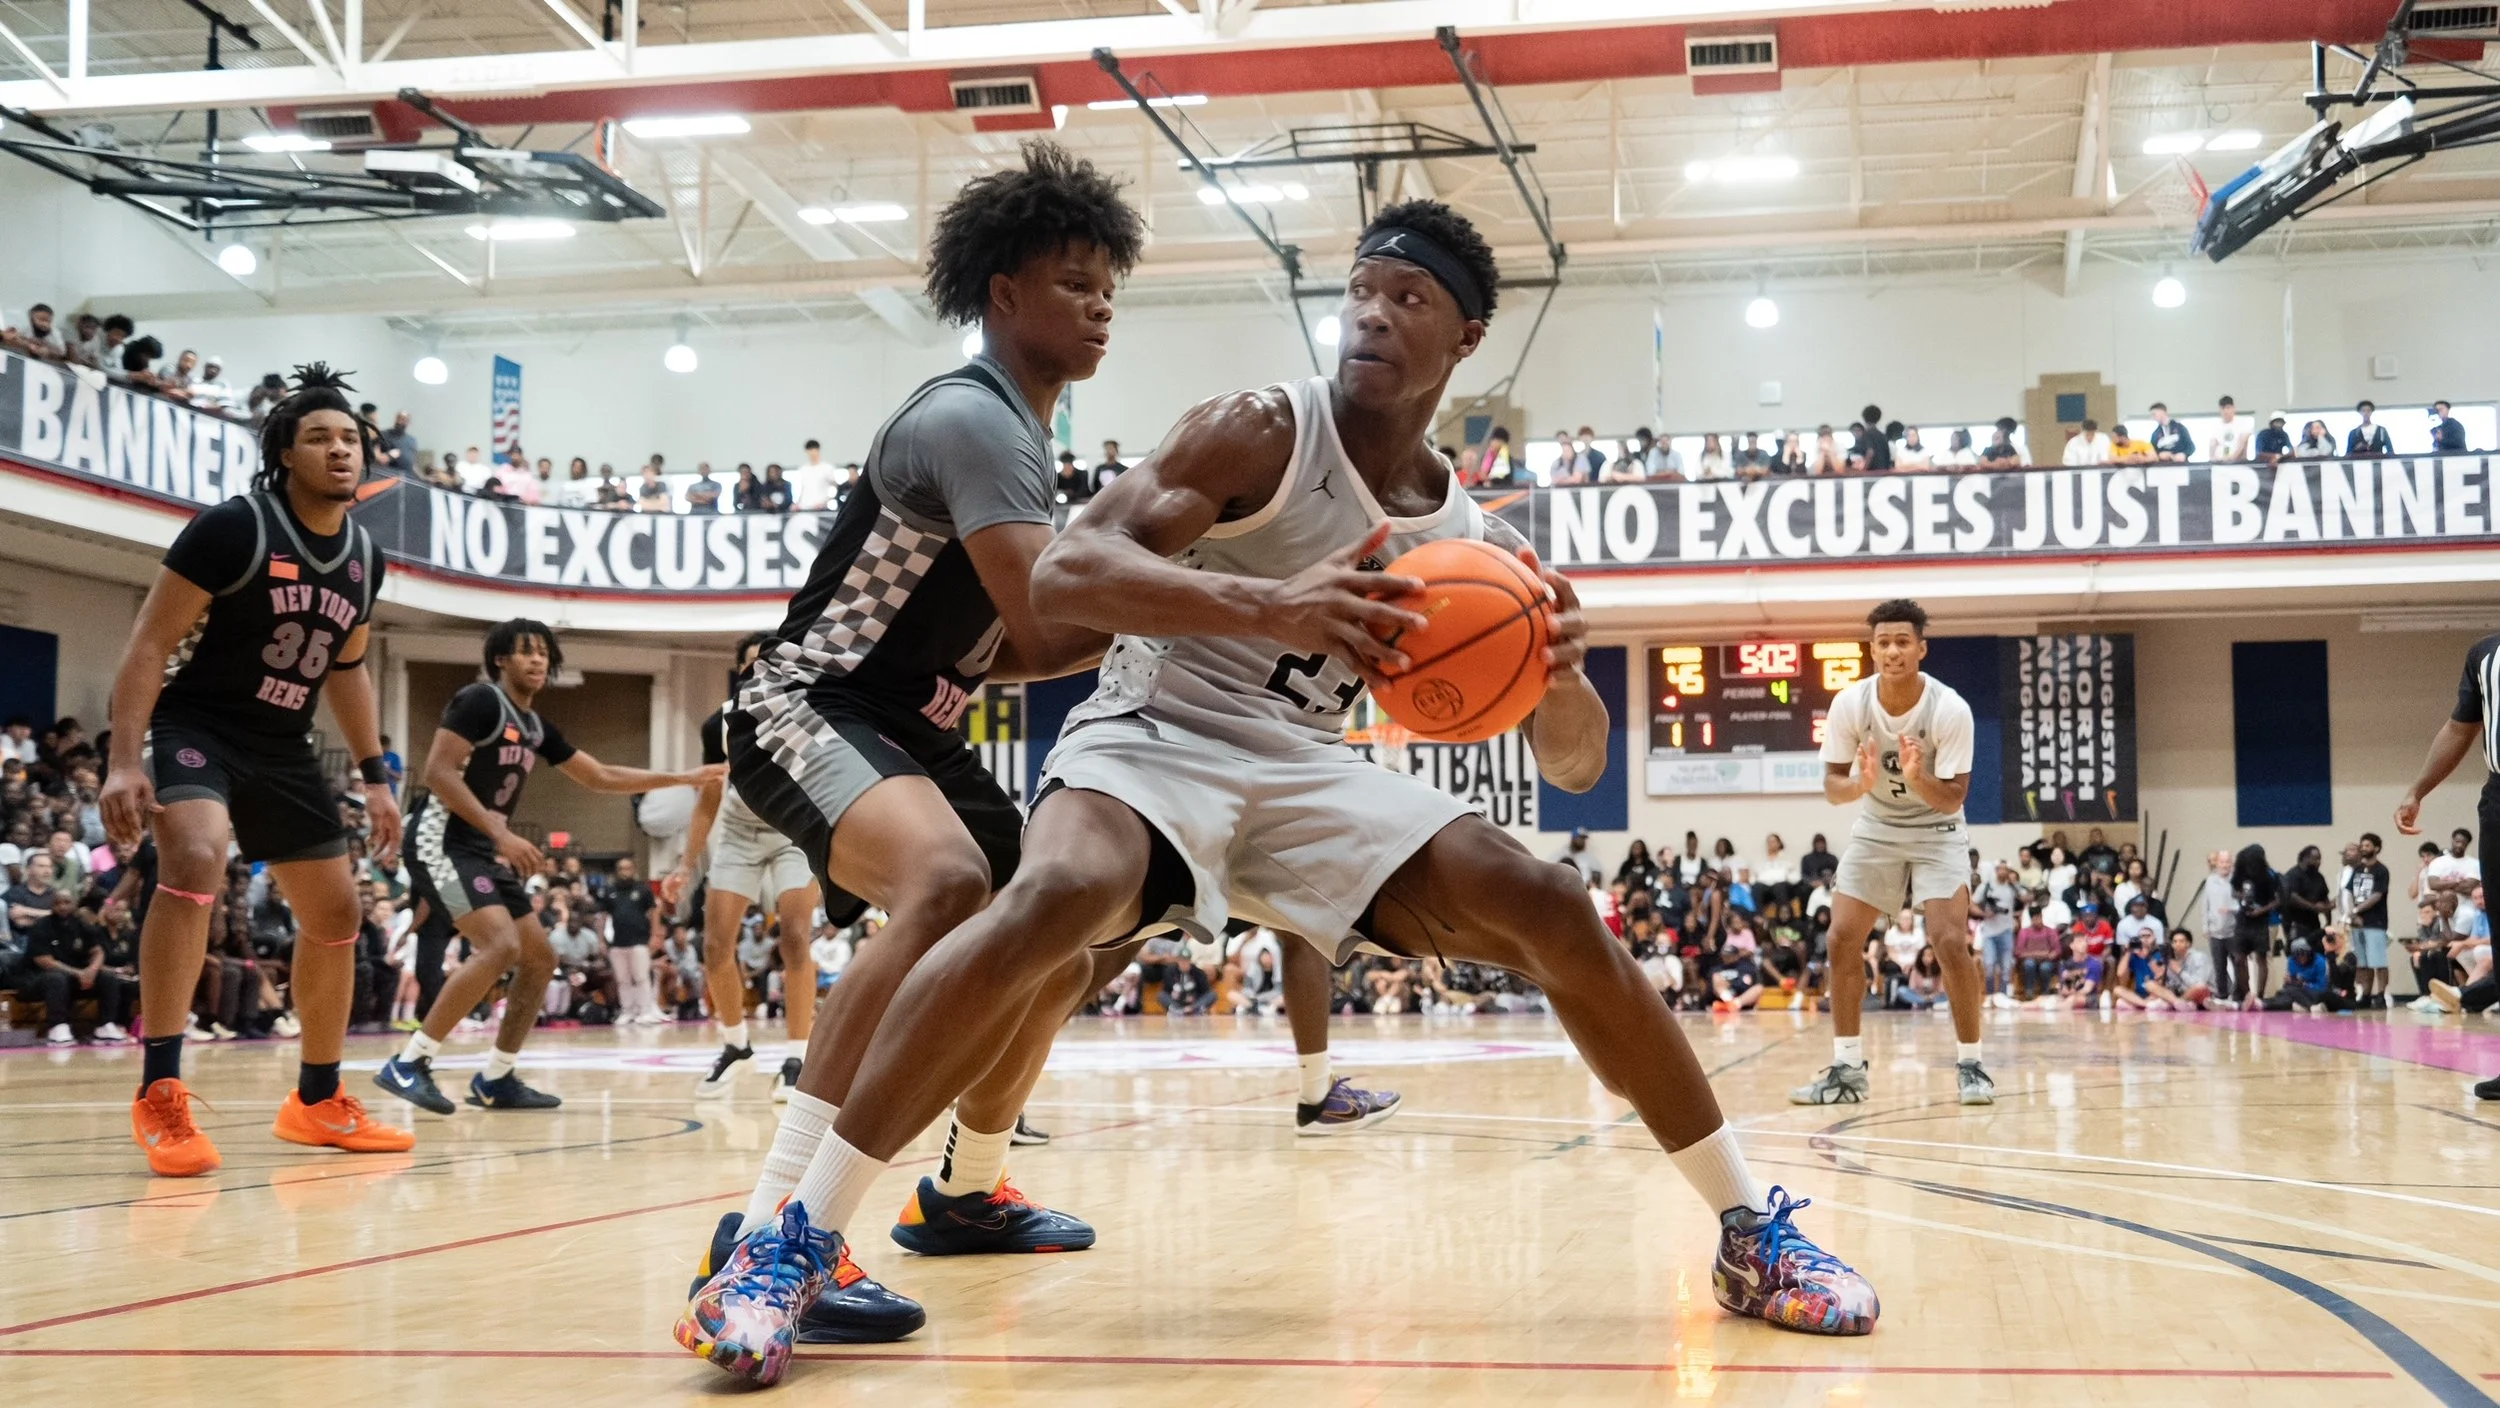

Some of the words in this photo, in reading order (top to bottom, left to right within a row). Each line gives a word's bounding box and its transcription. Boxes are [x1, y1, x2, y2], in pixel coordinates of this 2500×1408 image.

[21, 358, 263, 506] BANNER
[430, 488, 508, 577] NO
[526, 508, 820, 590] EXCUSES
[1551, 484, 1659, 565] NO
[1679, 474, 1994, 561] EXCUSES
[2012, 466, 2190, 551] JUST
[2212, 455, 2500, 544] BANNE
[269, 584, 312, 615] NEW
[318, 587, 357, 632] YORK
[1740, 643, 1796, 674] 5:02
[256, 675, 310, 710] RENS
[1771, 680, 1788, 703] 4
[1823, 659, 1861, 690] 62
[2019, 639, 2035, 788] AUGUSTA
[2037, 636, 2056, 801] NORTH
[2058, 638, 2074, 787] AUGUSTA
[2076, 635, 2095, 801] NORTH
[2100, 637, 2116, 787] AUGUSTA
[1407, 734, 1533, 794] ETBALL
